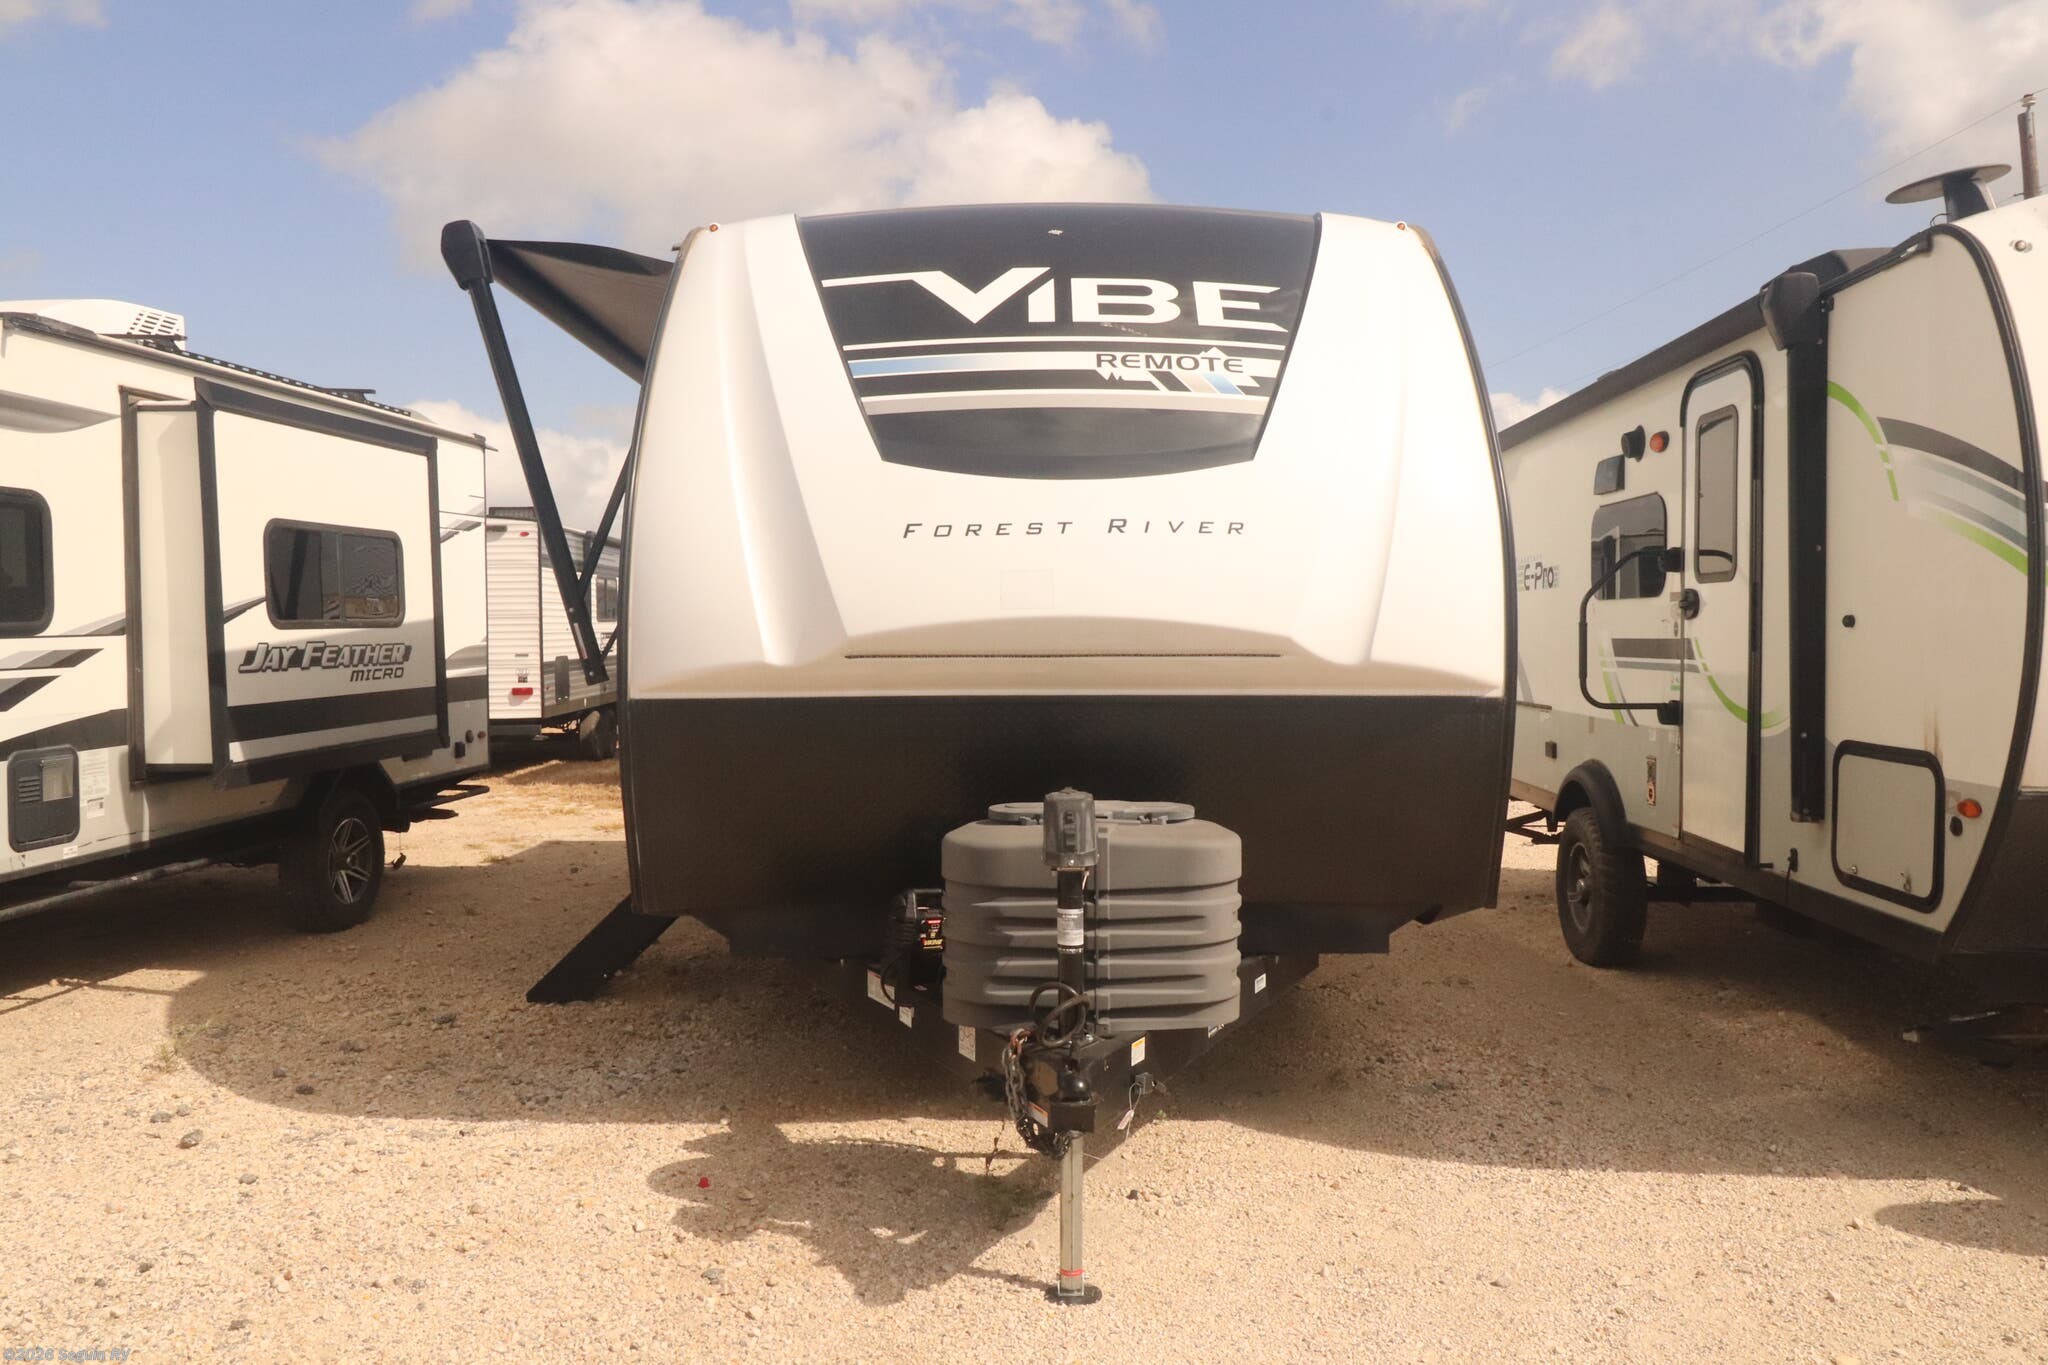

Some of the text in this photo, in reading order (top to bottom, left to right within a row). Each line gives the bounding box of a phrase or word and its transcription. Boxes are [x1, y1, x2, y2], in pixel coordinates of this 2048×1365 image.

[822, 267, 1288, 332] VIBE
[1096, 351, 1244, 374] REMOTE
[1523, 561, 1554, 591] E-Pro
[350, 667, 404, 682] MICRO
